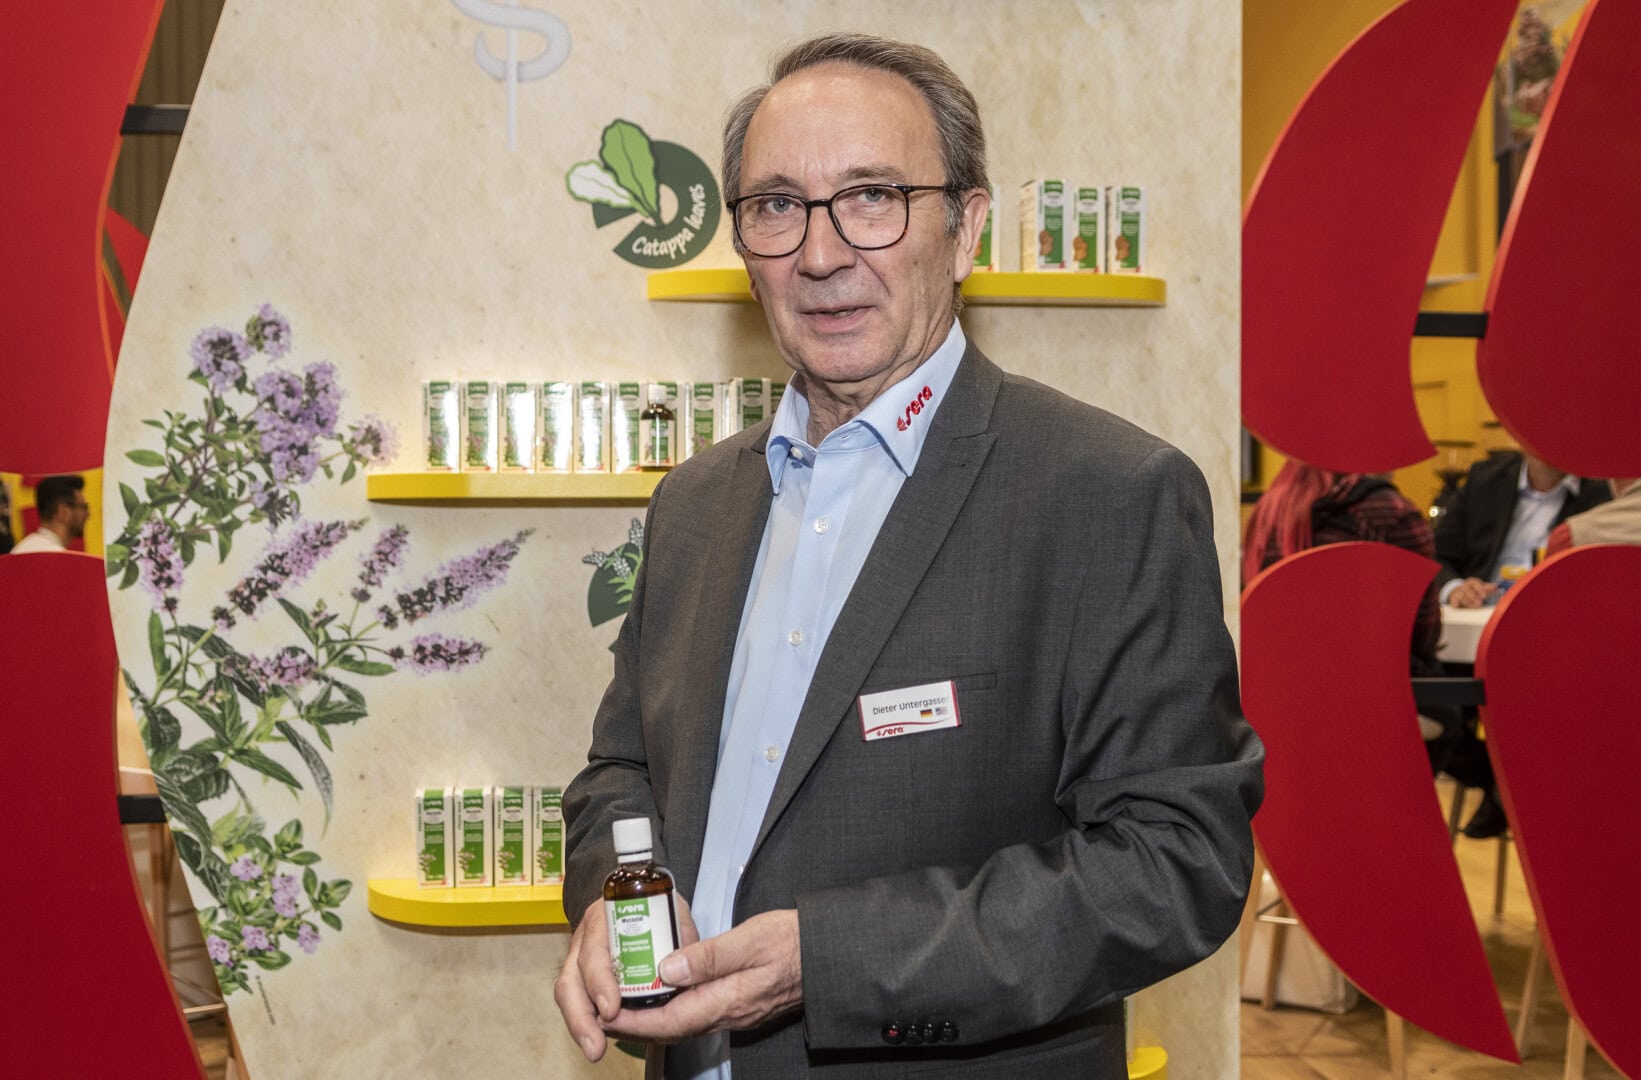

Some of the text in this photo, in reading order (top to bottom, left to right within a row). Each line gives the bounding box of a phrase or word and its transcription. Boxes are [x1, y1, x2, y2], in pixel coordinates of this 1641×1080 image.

[632, 183, 706, 260] Catappa leaves
[905, 385, 933, 426] sera
[872, 697, 948, 715] Dieter Untergasse
[881, 726, 904, 737] sera
